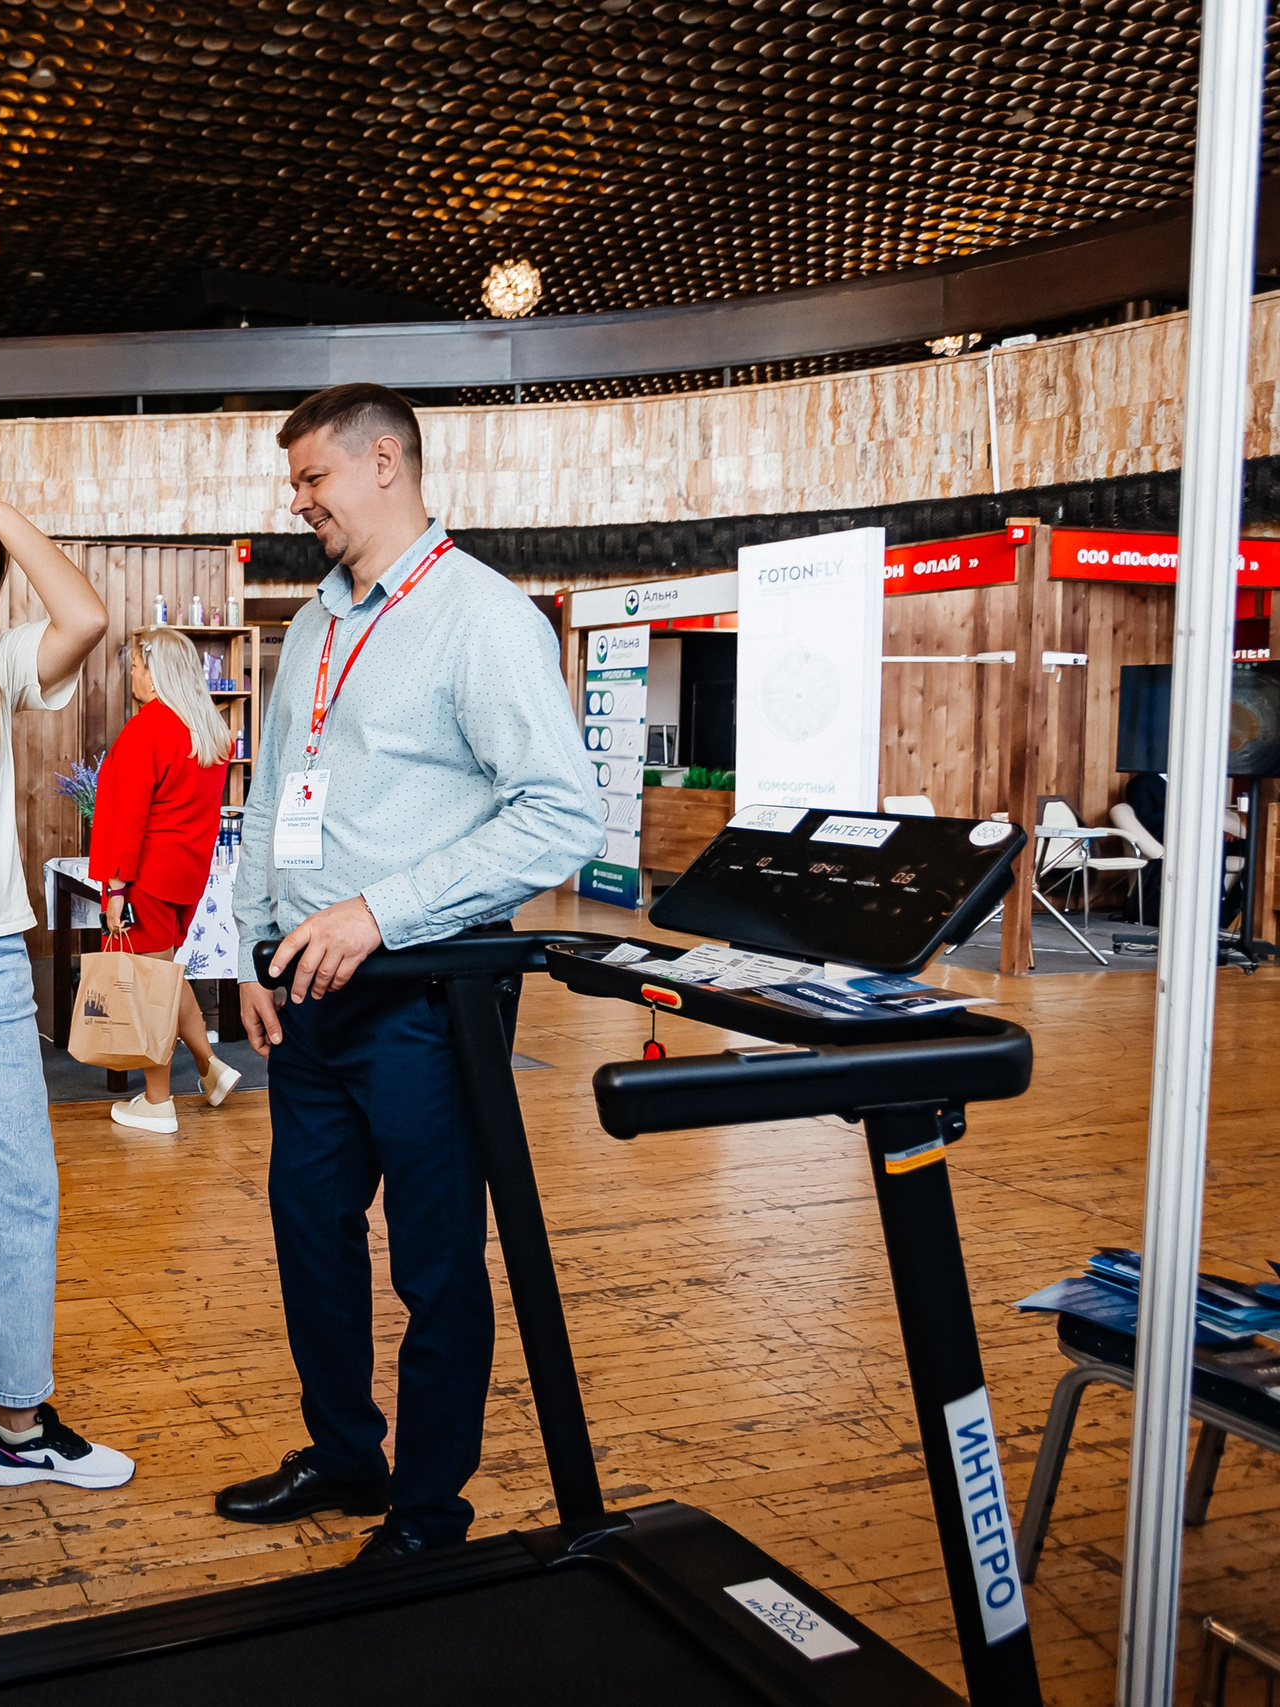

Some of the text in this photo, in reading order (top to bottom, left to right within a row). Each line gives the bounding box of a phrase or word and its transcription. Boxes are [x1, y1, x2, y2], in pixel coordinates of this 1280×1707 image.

[912, 553, 961, 576] ФЛАЙ
[1076, 548, 1110, 565] ООО
[1111, 550, 1179, 568] «ПО«ФОТ
[642, 589, 679, 604] Альна
[610, 636, 640, 650] Альна
[756, 780, 836, 795] КОМФОРТНЫЙ
[820, 822, 889, 840] ИНТЕГРО
[955, 1416, 1017, 1610] ИНТЕГРО
[744, 1598, 805, 1643] ИНТЕГРО
